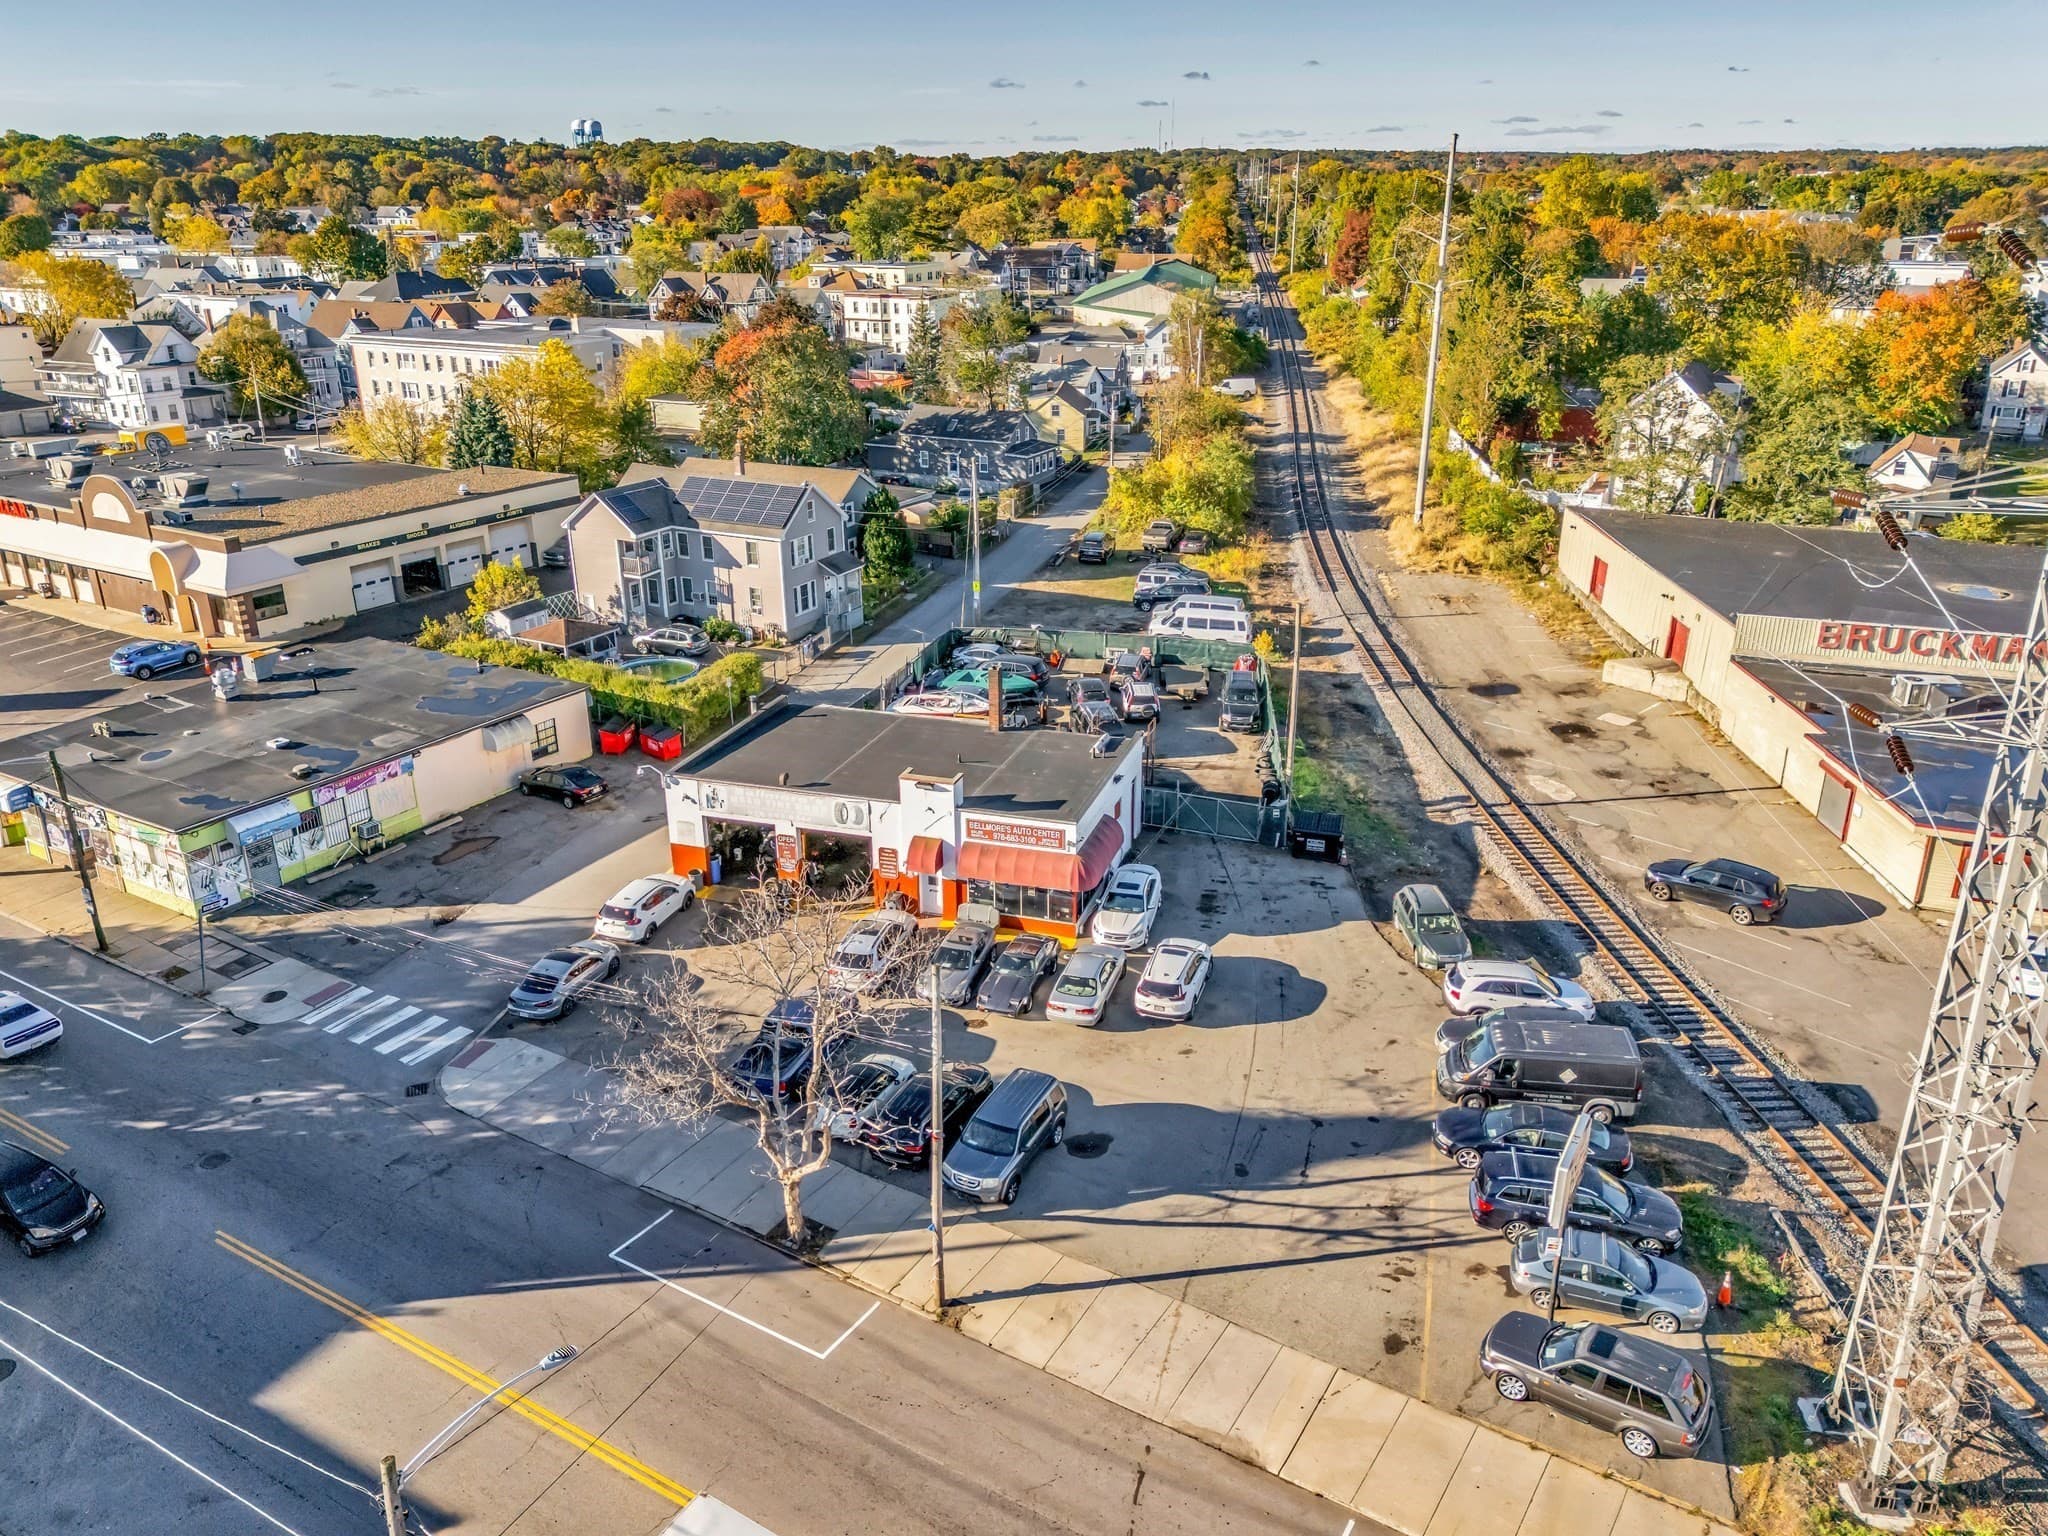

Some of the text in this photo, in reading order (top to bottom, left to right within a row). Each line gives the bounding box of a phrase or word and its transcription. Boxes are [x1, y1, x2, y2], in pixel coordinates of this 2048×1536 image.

[406, 530, 428, 539] SHOCKS
[357, 540, 381, 550] BRAKES
[969, 821, 1060, 839] BELLMORE'S AUTO CENTER
[778, 835, 796, 843] OPEN
